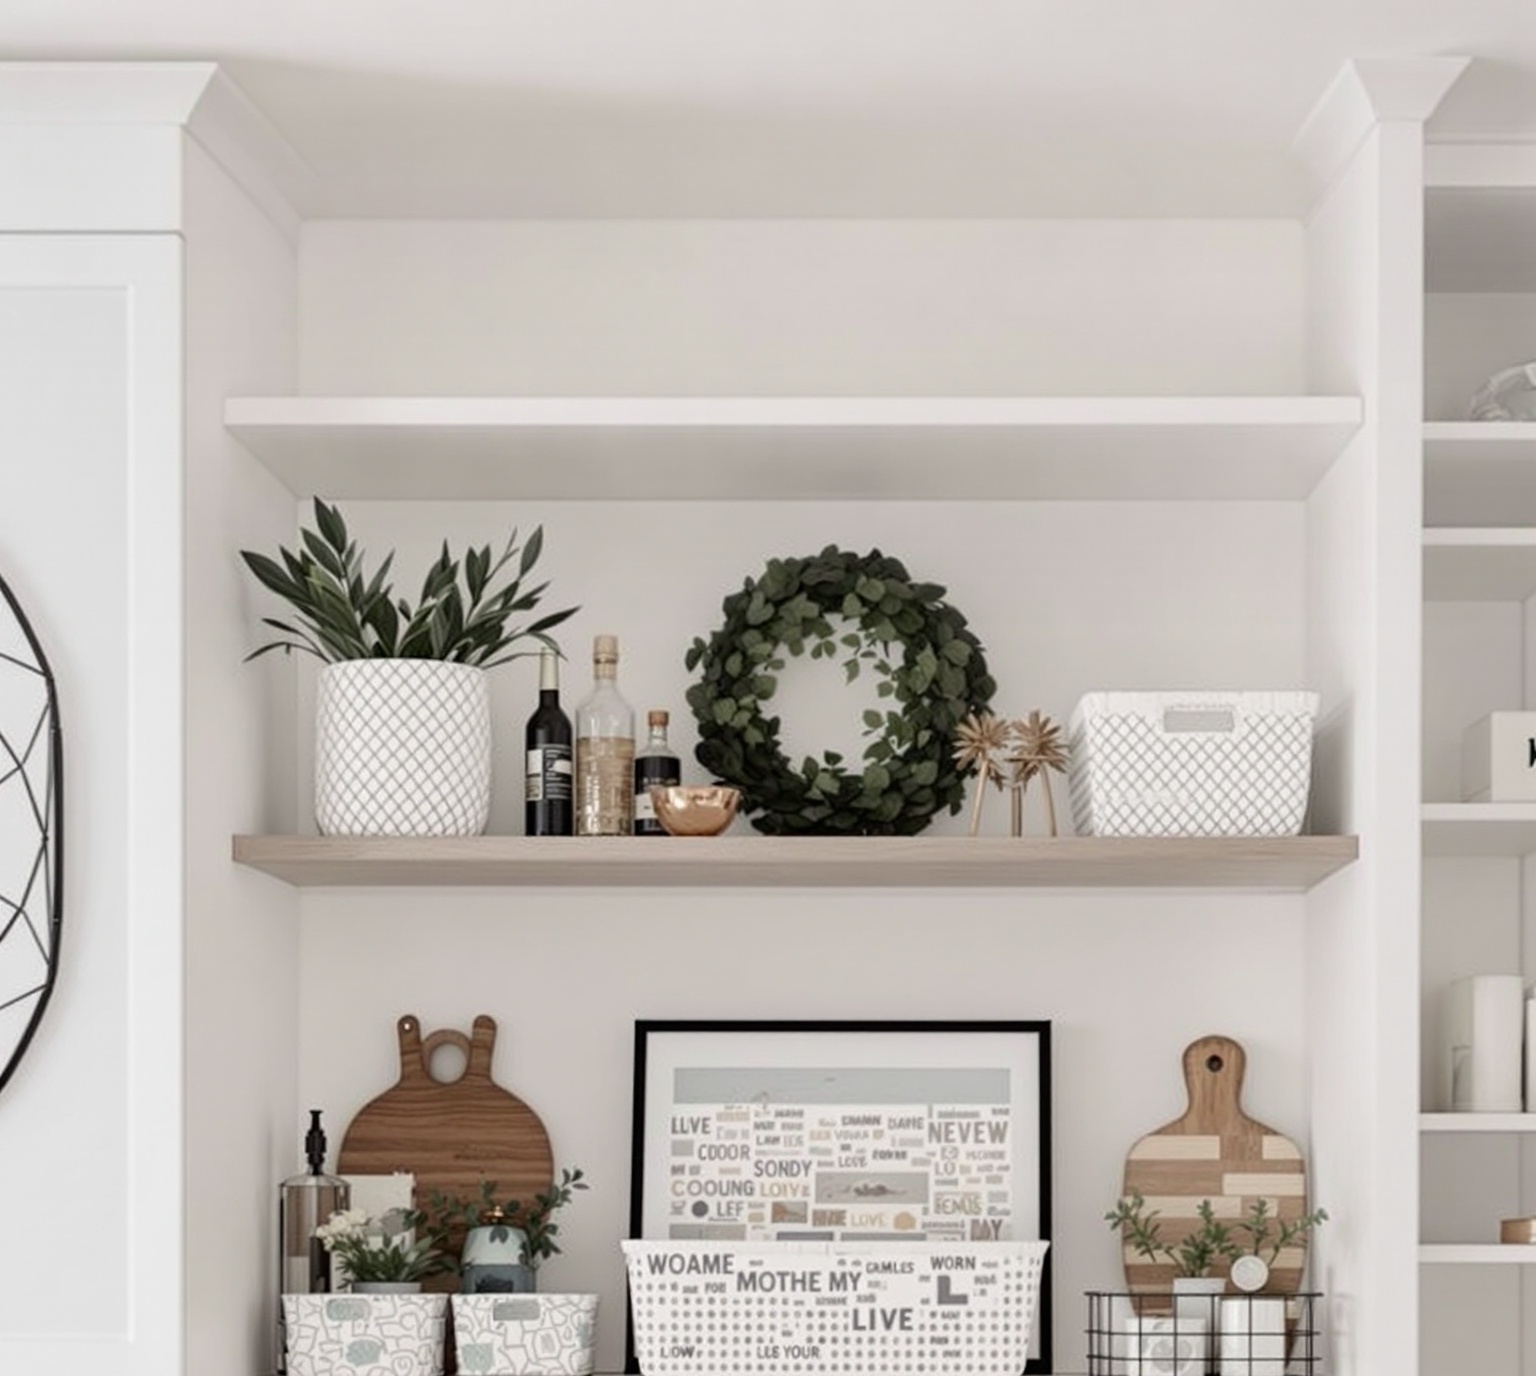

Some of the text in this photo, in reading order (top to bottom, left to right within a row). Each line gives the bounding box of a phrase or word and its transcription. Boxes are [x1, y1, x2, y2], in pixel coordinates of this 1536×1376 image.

[928, 1121, 1008, 1144] NEVEW
[647, 1253, 735, 1276] WOAME
[930, 1256, 977, 1271] WORN
[736, 1270, 822, 1293] MOTHE
[828, 1270, 862, 1293] MY
[852, 1307, 914, 1332] LIVE
